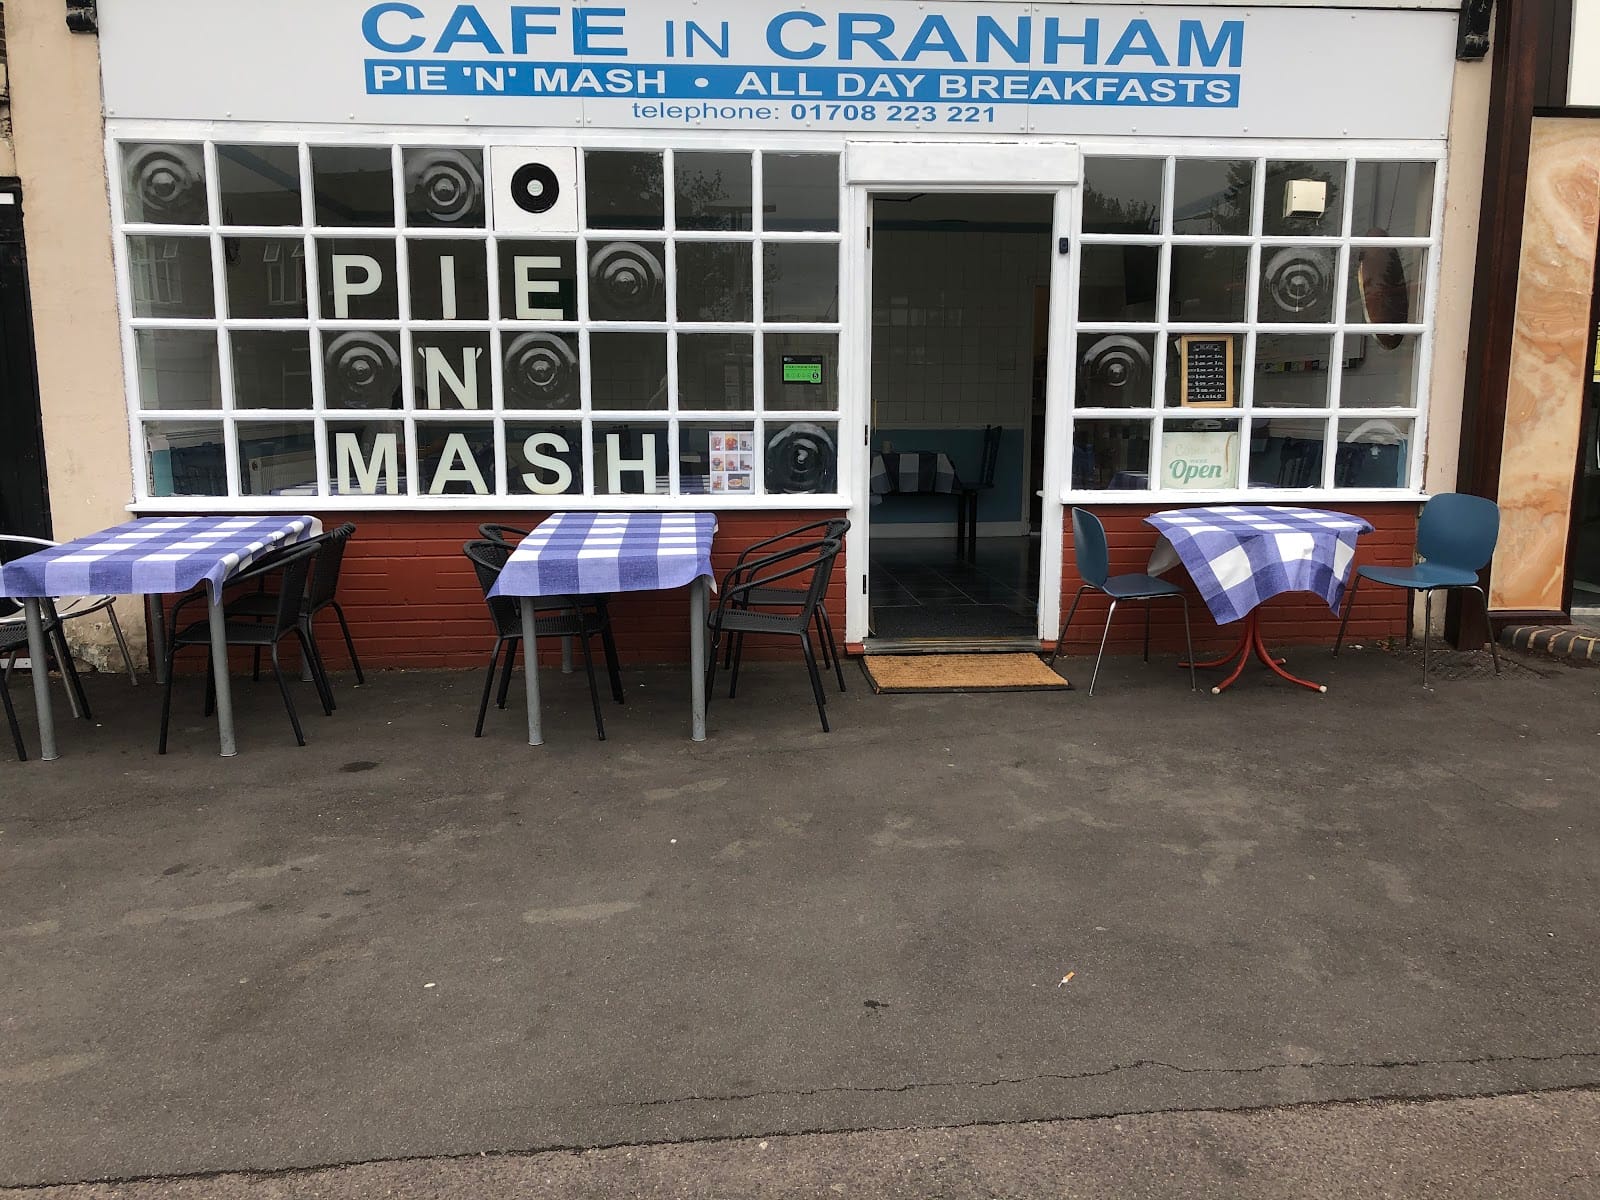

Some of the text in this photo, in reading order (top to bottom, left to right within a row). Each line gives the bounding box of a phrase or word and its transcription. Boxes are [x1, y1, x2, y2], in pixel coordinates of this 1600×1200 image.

[362, 2, 1245, 68] CAFE IN CRANHAM
[373, 65, 1231, 104] PIE 'N' MASH ALL DAY BREAKFASTS
[632, 102, 995, 122] telephone: 01708 223 221
[332, 254, 565, 321] PIE
[335, 432, 659, 496] MASH
[1169, 459, 1223, 485] Open
